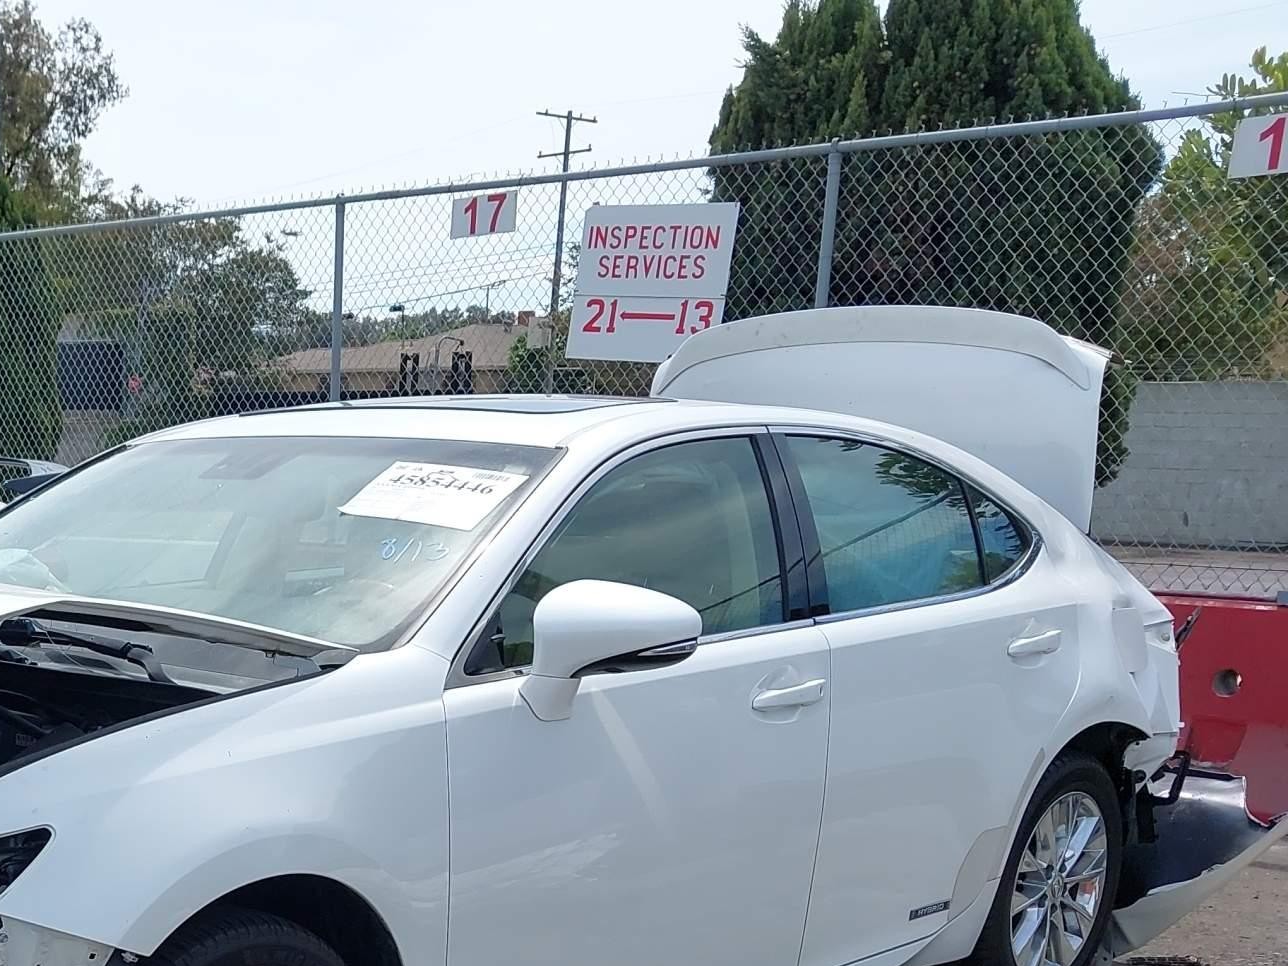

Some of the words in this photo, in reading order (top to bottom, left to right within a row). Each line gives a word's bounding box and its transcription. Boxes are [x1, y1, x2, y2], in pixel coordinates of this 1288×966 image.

[464, 193, 507, 235] 17
[587, 225, 721, 250] INSPECTION
[597, 254, 706, 279] SERVICES
[582, 298, 618, 333] 21
[675, 299, 714, 335] 13
[390, 473, 494, 495] 45854446
[917, 903, 945, 916] HYBRID
